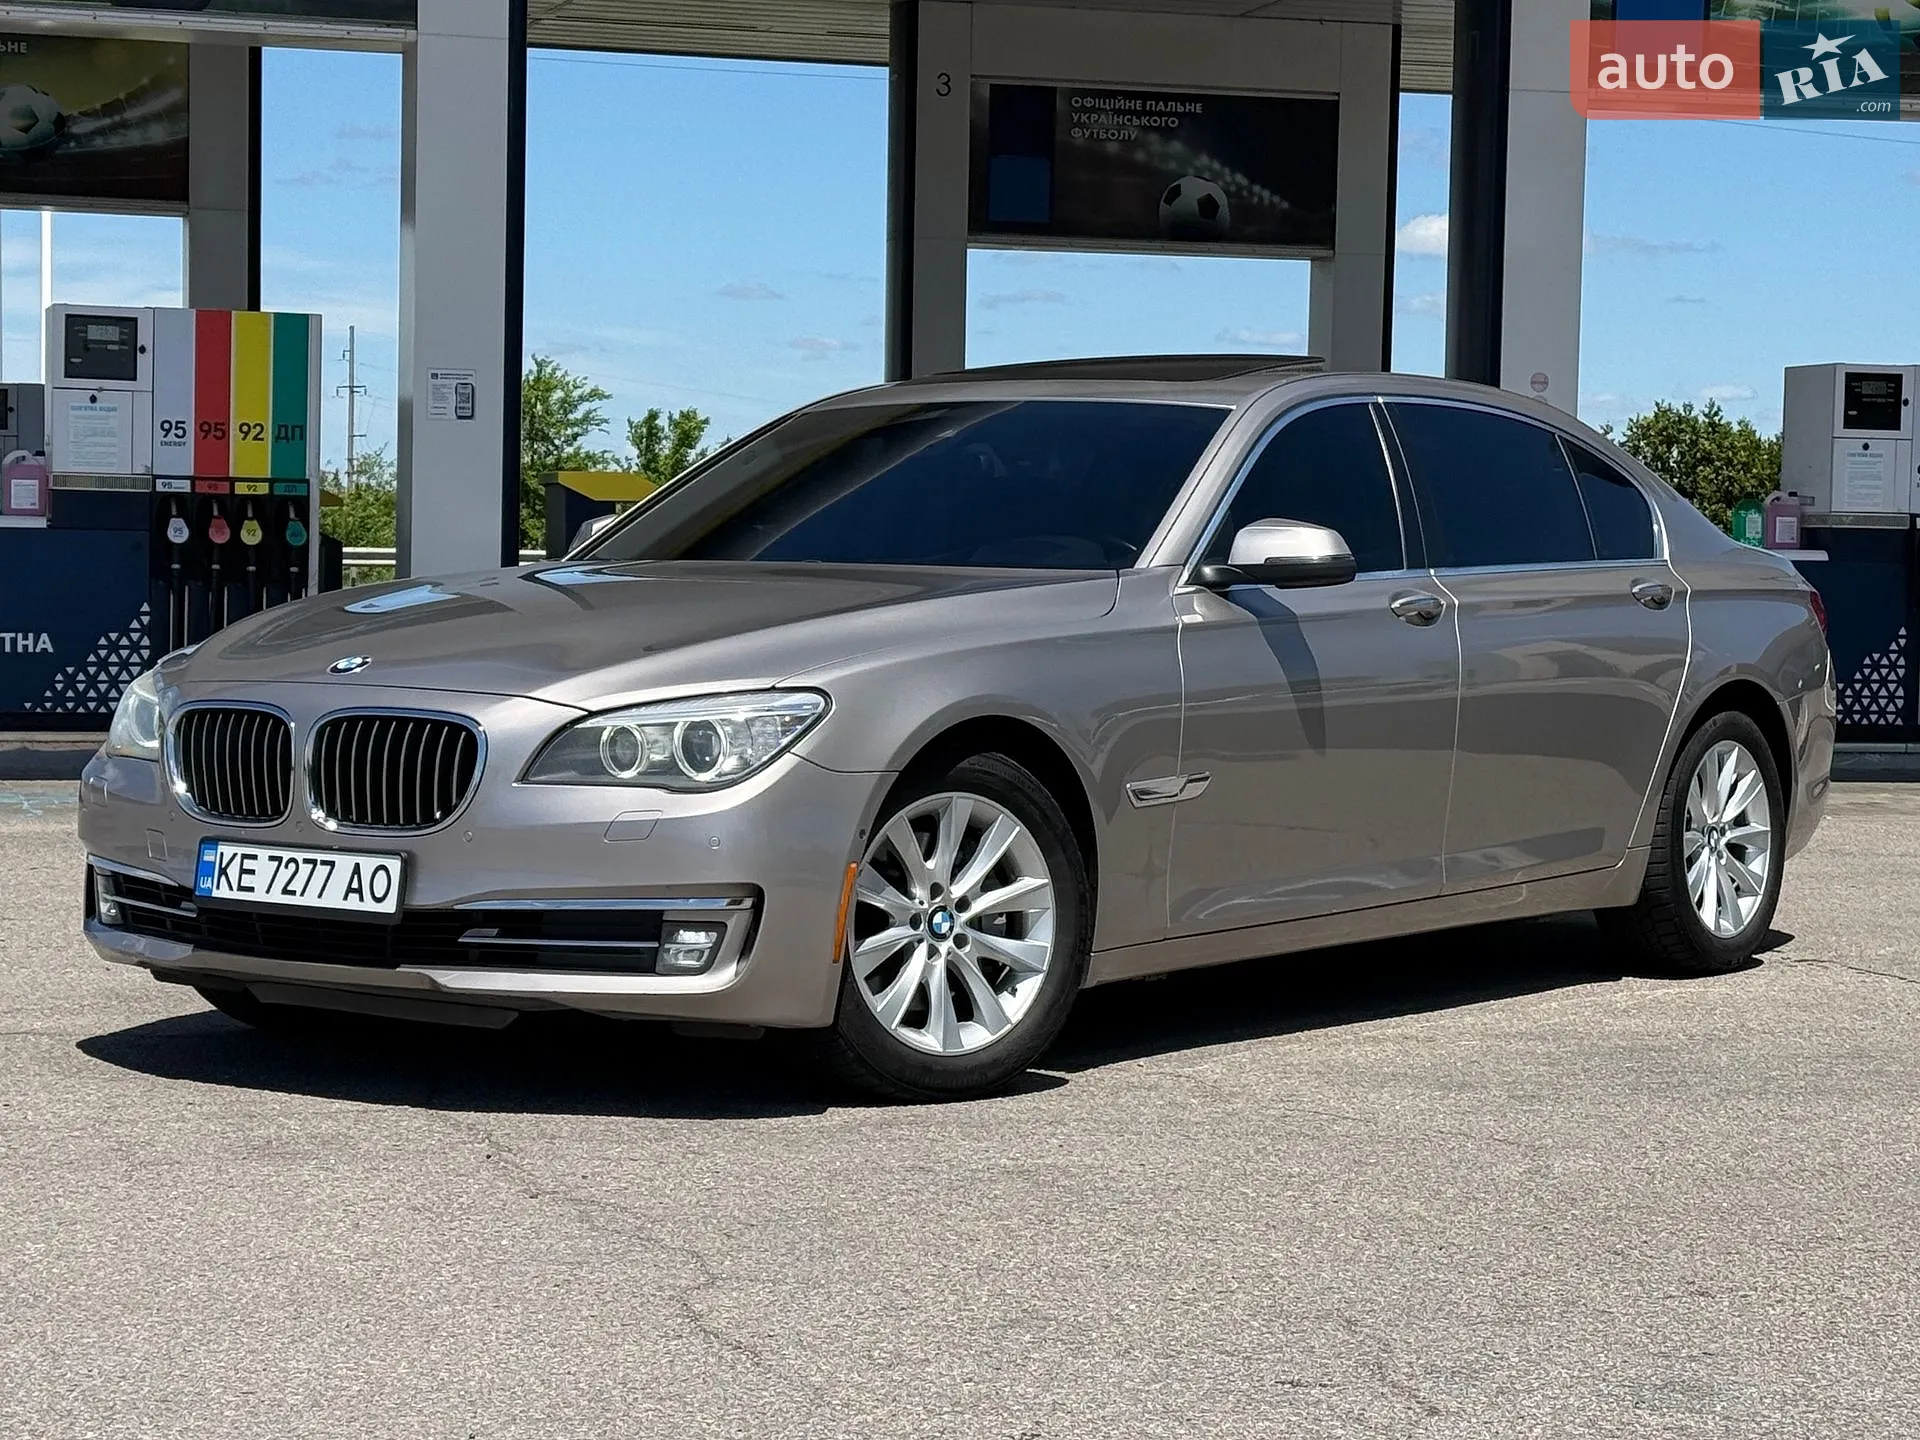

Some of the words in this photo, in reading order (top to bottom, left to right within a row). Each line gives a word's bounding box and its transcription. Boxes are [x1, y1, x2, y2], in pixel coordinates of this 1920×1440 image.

[934, 72, 952, 97] 3
[1070, 95, 1143, 111] ОФІЦІЙНЕ
[1145, 100, 1204, 114] ПАЛЬНЕ
[1070, 111, 1180, 128] УКРАЇНСЬКОГО
[1070, 127, 1138, 141] ФУТБОЛУ
[159, 419, 187, 439] 95
[198, 420, 226, 441] 95
[238, 421, 265, 442] 92
[274, 423, 305, 443] ДП
[246, 483, 258, 492] 92
[172, 526, 184, 535] 95
[246, 528, 257, 537] 92
[200, 876, 213, 889] UA
[215, 851, 259, 894] KE
[265, 854, 336, 899] 7277
[342, 862, 392, 903] AO
